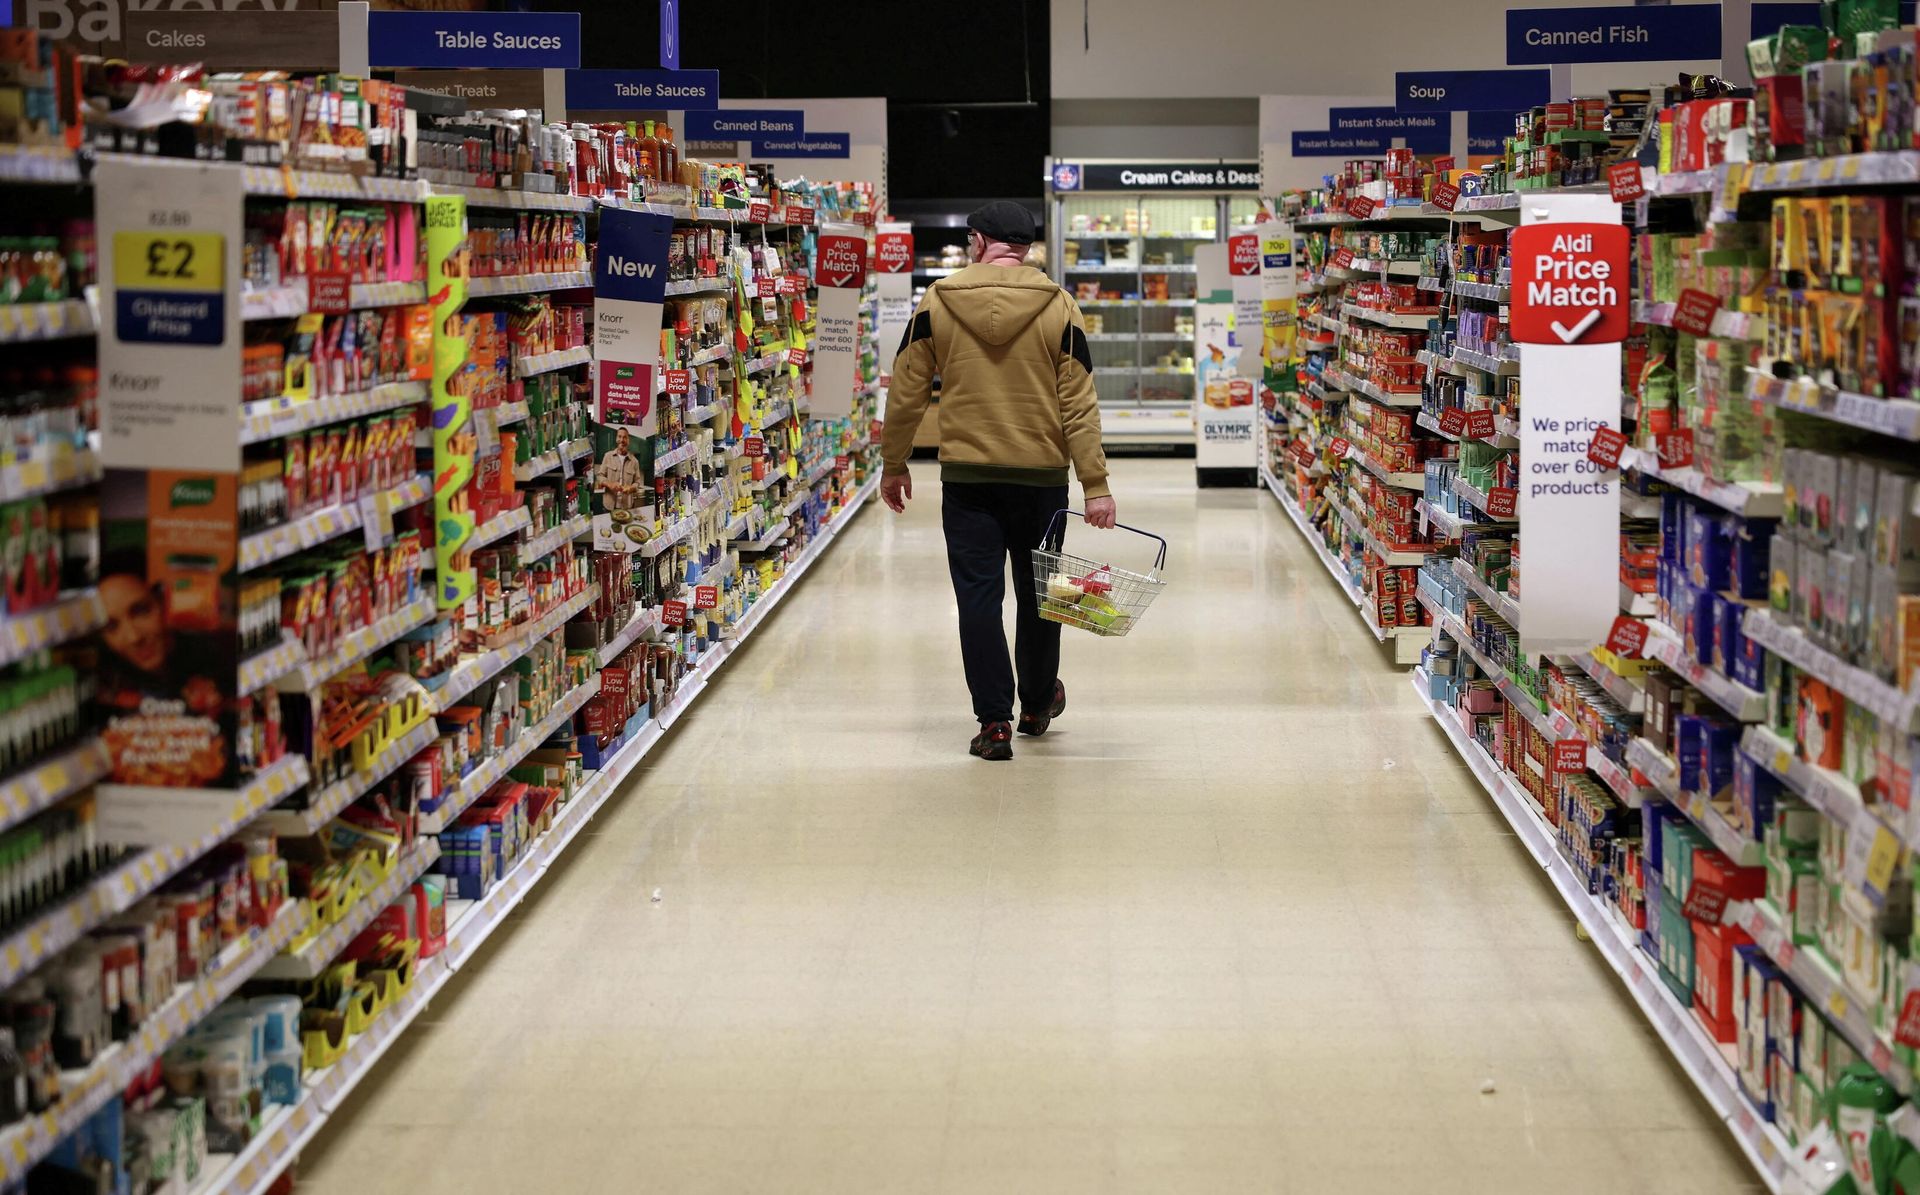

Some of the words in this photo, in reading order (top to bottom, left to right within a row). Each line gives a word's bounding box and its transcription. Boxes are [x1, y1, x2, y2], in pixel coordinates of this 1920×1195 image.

[146, 30, 206, 47] Cakes
[435, 31, 488, 49] Table
[492, 32, 562, 50] Sauces
[1525, 26, 1602, 46] Canned
[1609, 25, 1649, 43] Fish
[409, 85, 450, 96] eet
[454, 84, 497, 97] Treats
[614, 83, 652, 97] Table
[656, 84, 706, 97] Sauces
[1409, 85, 1446, 100] Soup
[713, 120, 757, 131] Canned
[760, 121, 794, 131] Beans
[1338, 117, 1374, 128] Instant
[1376, 117, 1406, 128] Snack
[1407, 116, 1436, 127] Meals
[764, 141, 796, 150] Canned
[798, 140, 842, 151] Vegetables
[1299, 139, 1328, 148] Instant
[1330, 138, 1354, 148] Snack
[1355, 138, 1380, 147] Meals
[1468, 138, 1497, 148] Crisps
[1120, 170, 1168, 185] Cream
[1171, 170, 1213, 184] Cakes
[1215, 170, 1226, 184] &
[1228, 170, 1262, 184] Dess
[1613, 175, 1637, 187] Low
[1438, 190, 1453, 200] Low
[1613, 183, 1642, 199] Price
[1434, 195, 1452, 207] Price
[834, 240, 852, 250] Aldi
[882, 243, 908, 253] Price
[1268, 241, 1285, 250] 70p
[1551, 234, 1593, 253] Aldi
[826, 249, 858, 262] Price
[1236, 246, 1259, 254] Pric
[146, 239, 196, 278] £2
[880, 251, 910, 262] Match
[1233, 255, 1259, 264] Matc
[607, 255, 657, 279] New
[823, 260, 860, 273] Match
[1535, 255, 1611, 280] Price
[1527, 282, 1617, 307] Match
[599, 312, 624, 323] Knorr
[821, 317, 833, 325] We
[834, 318, 854, 327] price
[825, 326, 848, 334] match
[819, 344, 852, 353] products
[668, 383, 687, 391] Price
[623, 392, 641, 400] night
[1446, 415, 1461, 425] Low
[1472, 419, 1489, 427] Low
[1532, 417, 1560, 432] We
[1204, 424, 1252, 434] OLYMPIC
[1441, 421, 1461, 432] Price
[1471, 427, 1492, 435] Price
[1596, 437, 1618, 452] Low
[1590, 446, 1617, 463] Price
[1531, 462, 1570, 474] over
[1531, 480, 1610, 498] products
[1493, 496, 1511, 504] Low
[1490, 503, 1512, 514] Price
[631, 562, 641, 571] HP
[667, 608, 682, 616] Low
[664, 615, 683, 624] Price
[605, 677, 623, 685] Low
[603, 684, 625, 693] Price
[1560, 750, 1581, 760] Low
[1557, 759, 1584, 769] Price
